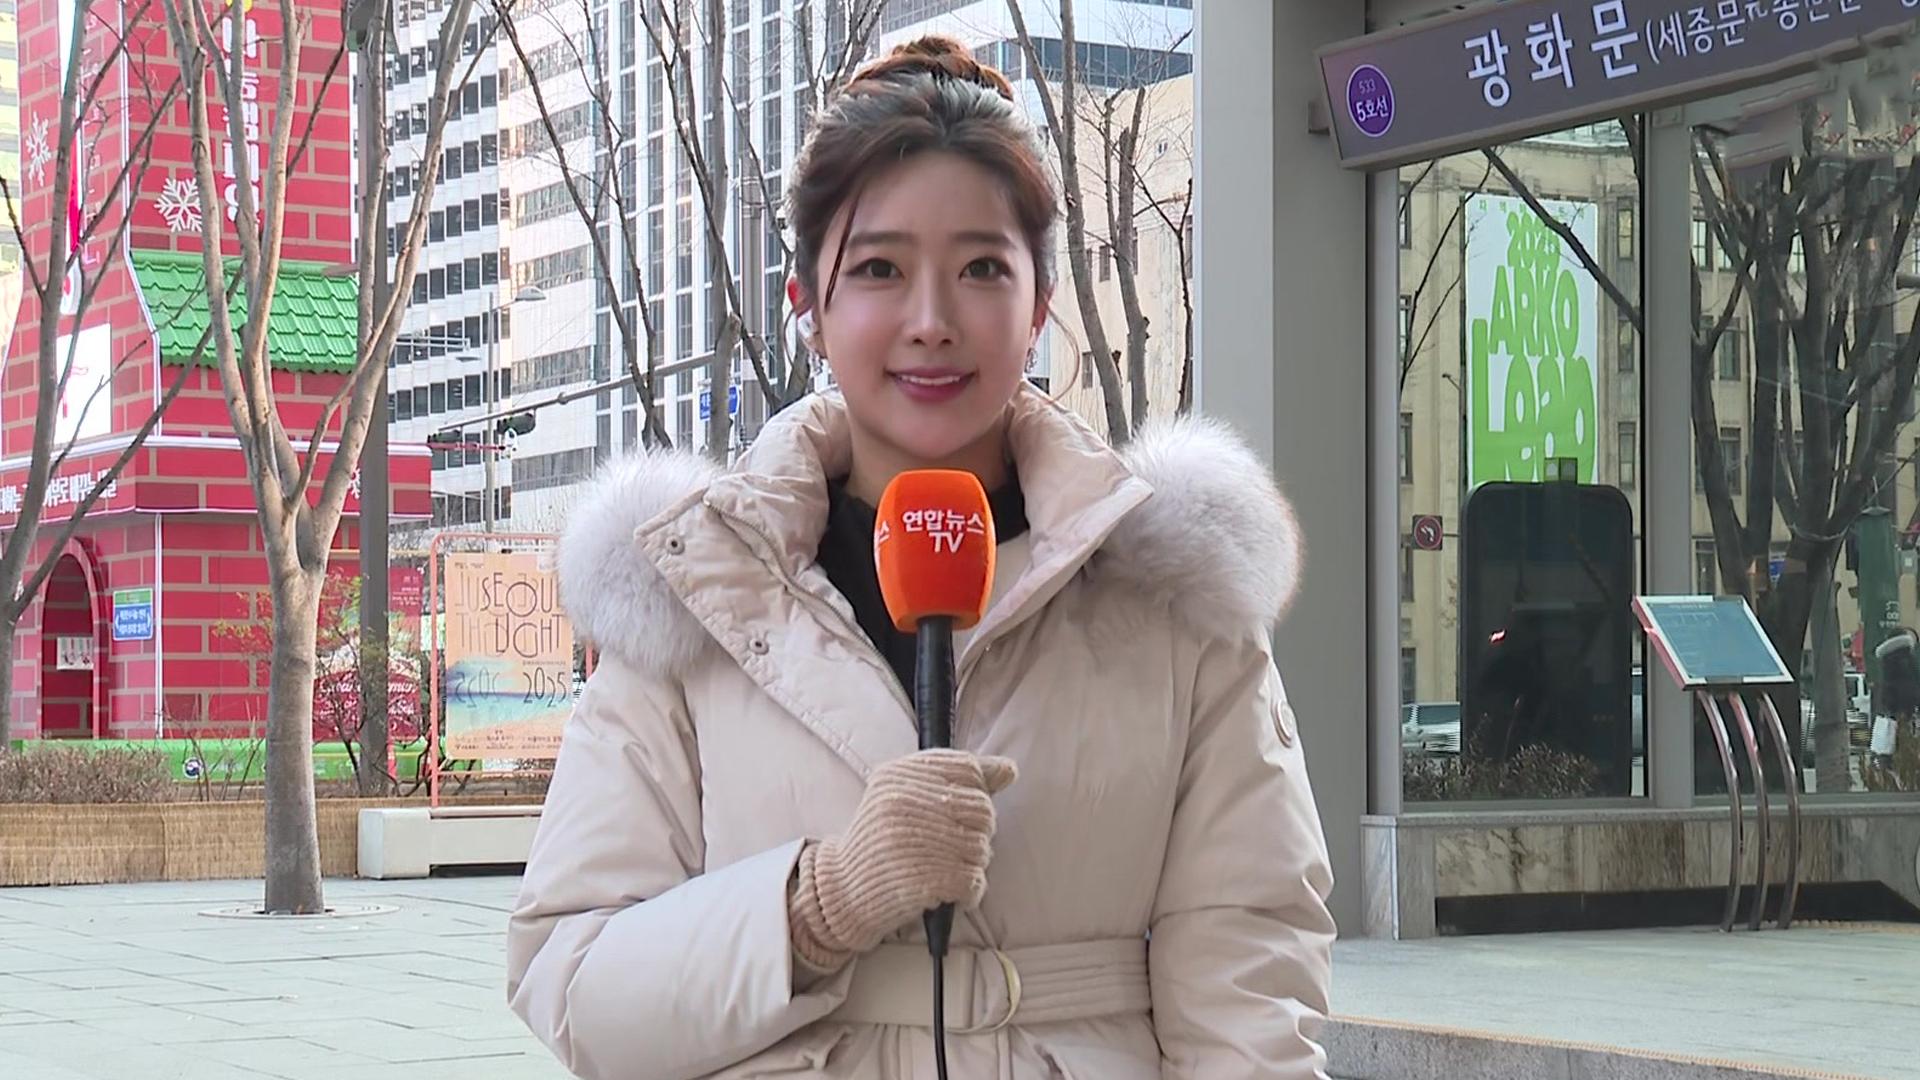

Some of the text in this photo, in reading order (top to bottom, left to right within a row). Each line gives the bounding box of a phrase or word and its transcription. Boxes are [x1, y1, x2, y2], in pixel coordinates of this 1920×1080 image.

[1464, 0, 1640, 107] 광화문
[1356, 95, 1389, 122] 5호선
[1489, 264, 1580, 358] ARKO
[902, 509, 985, 534] 연합뉴스
[928, 531, 964, 553] TV
[523, 667, 567, 708] 2025
